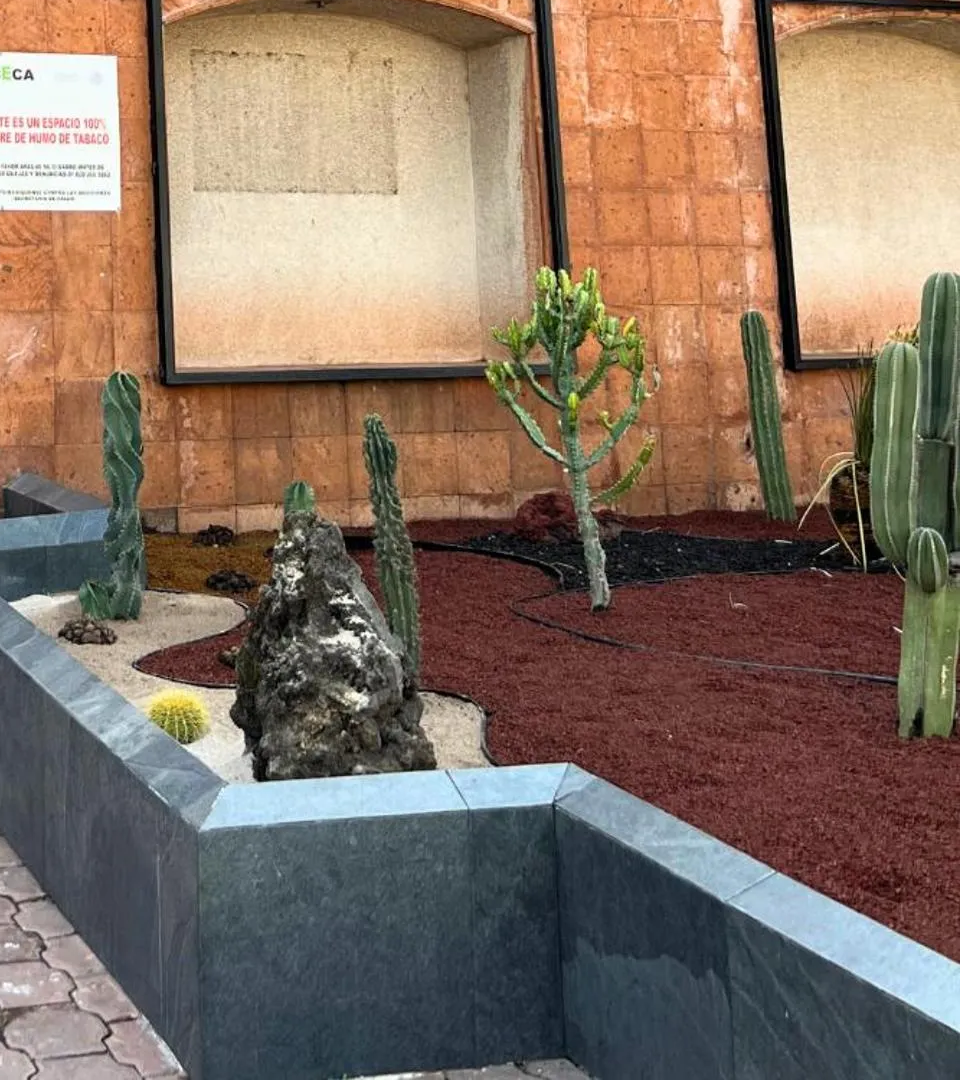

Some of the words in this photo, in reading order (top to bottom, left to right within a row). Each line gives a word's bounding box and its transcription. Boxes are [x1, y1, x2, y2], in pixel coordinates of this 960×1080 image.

[13, 117, 25, 128] ES
[27, 117, 40, 128] UN
[42, 117, 81, 129] ESPACIO
[15, 132, 26, 144] DE
[28, 132, 57, 144] HUMO
[60, 133, 71, 144] DE
[74, 133, 110, 145] TABACO
